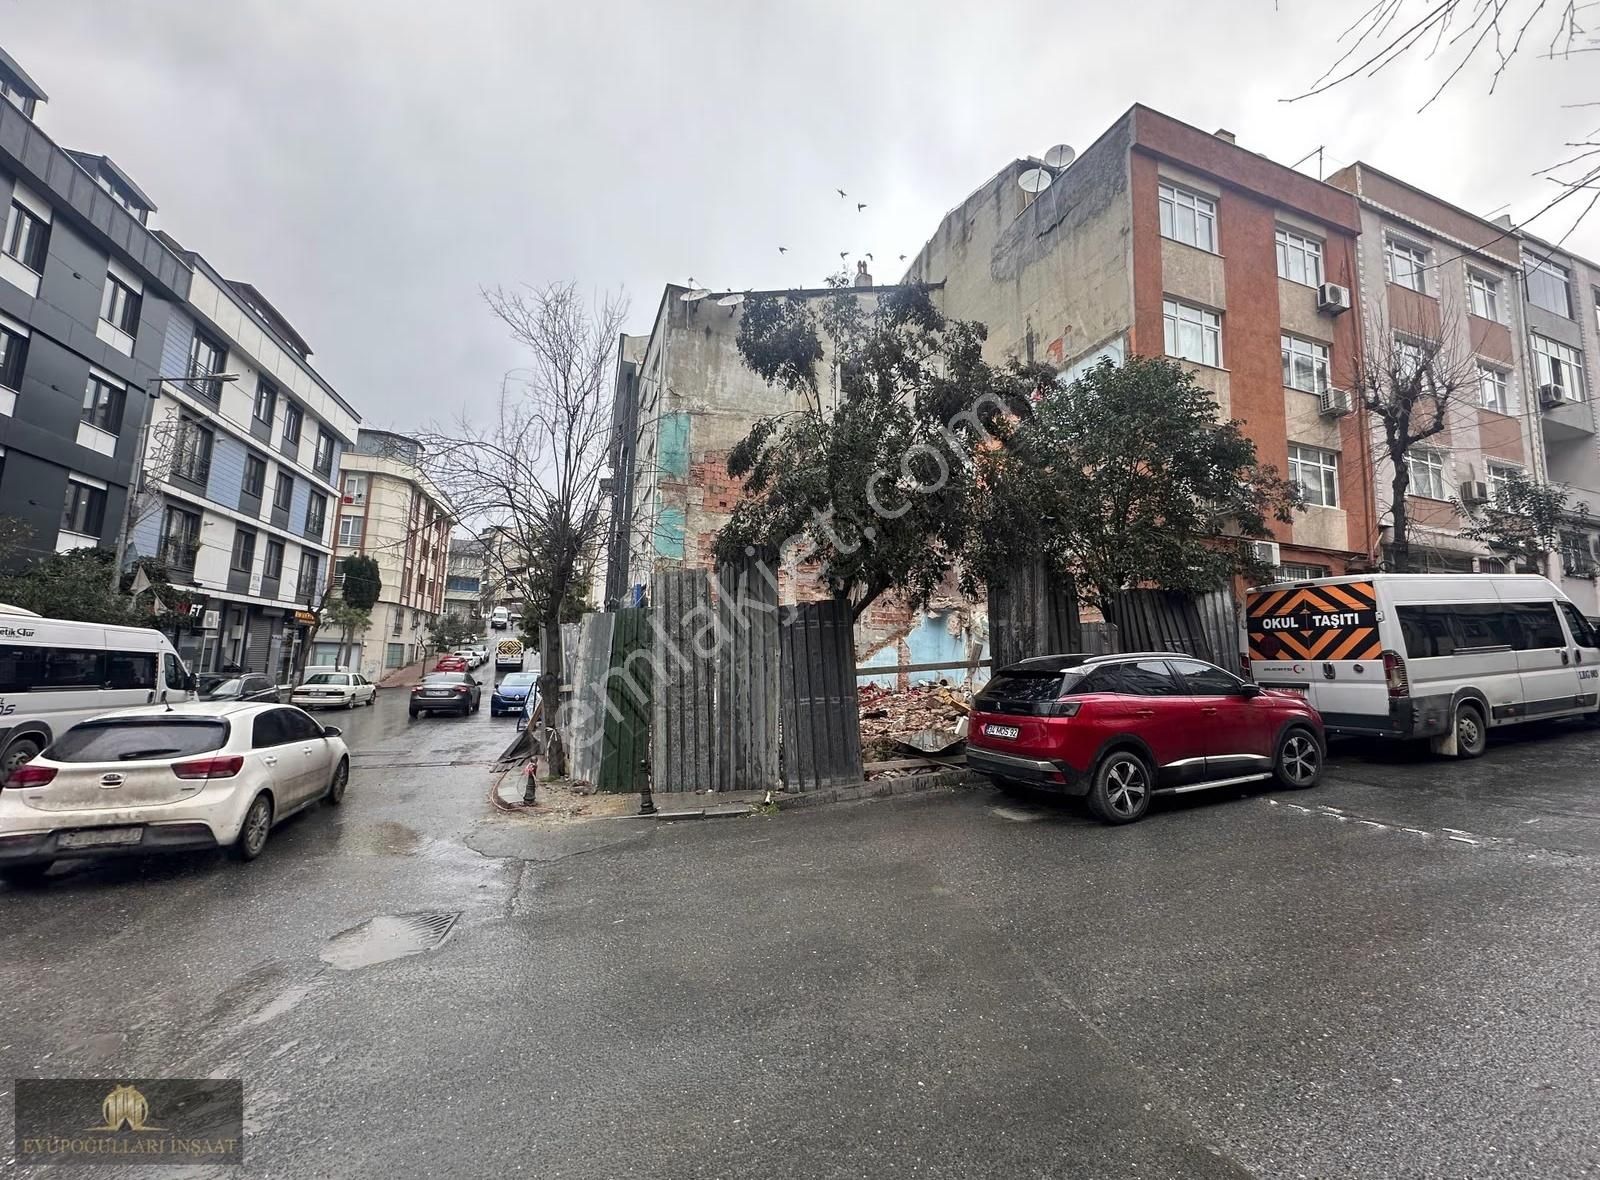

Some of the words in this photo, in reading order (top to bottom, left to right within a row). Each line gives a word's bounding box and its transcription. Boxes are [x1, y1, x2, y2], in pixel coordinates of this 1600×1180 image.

[1263, 616, 1298, 629] OKUL
[1312, 613, 1359, 628] TAŞITI
[1009, 728, 1018, 737] 92
